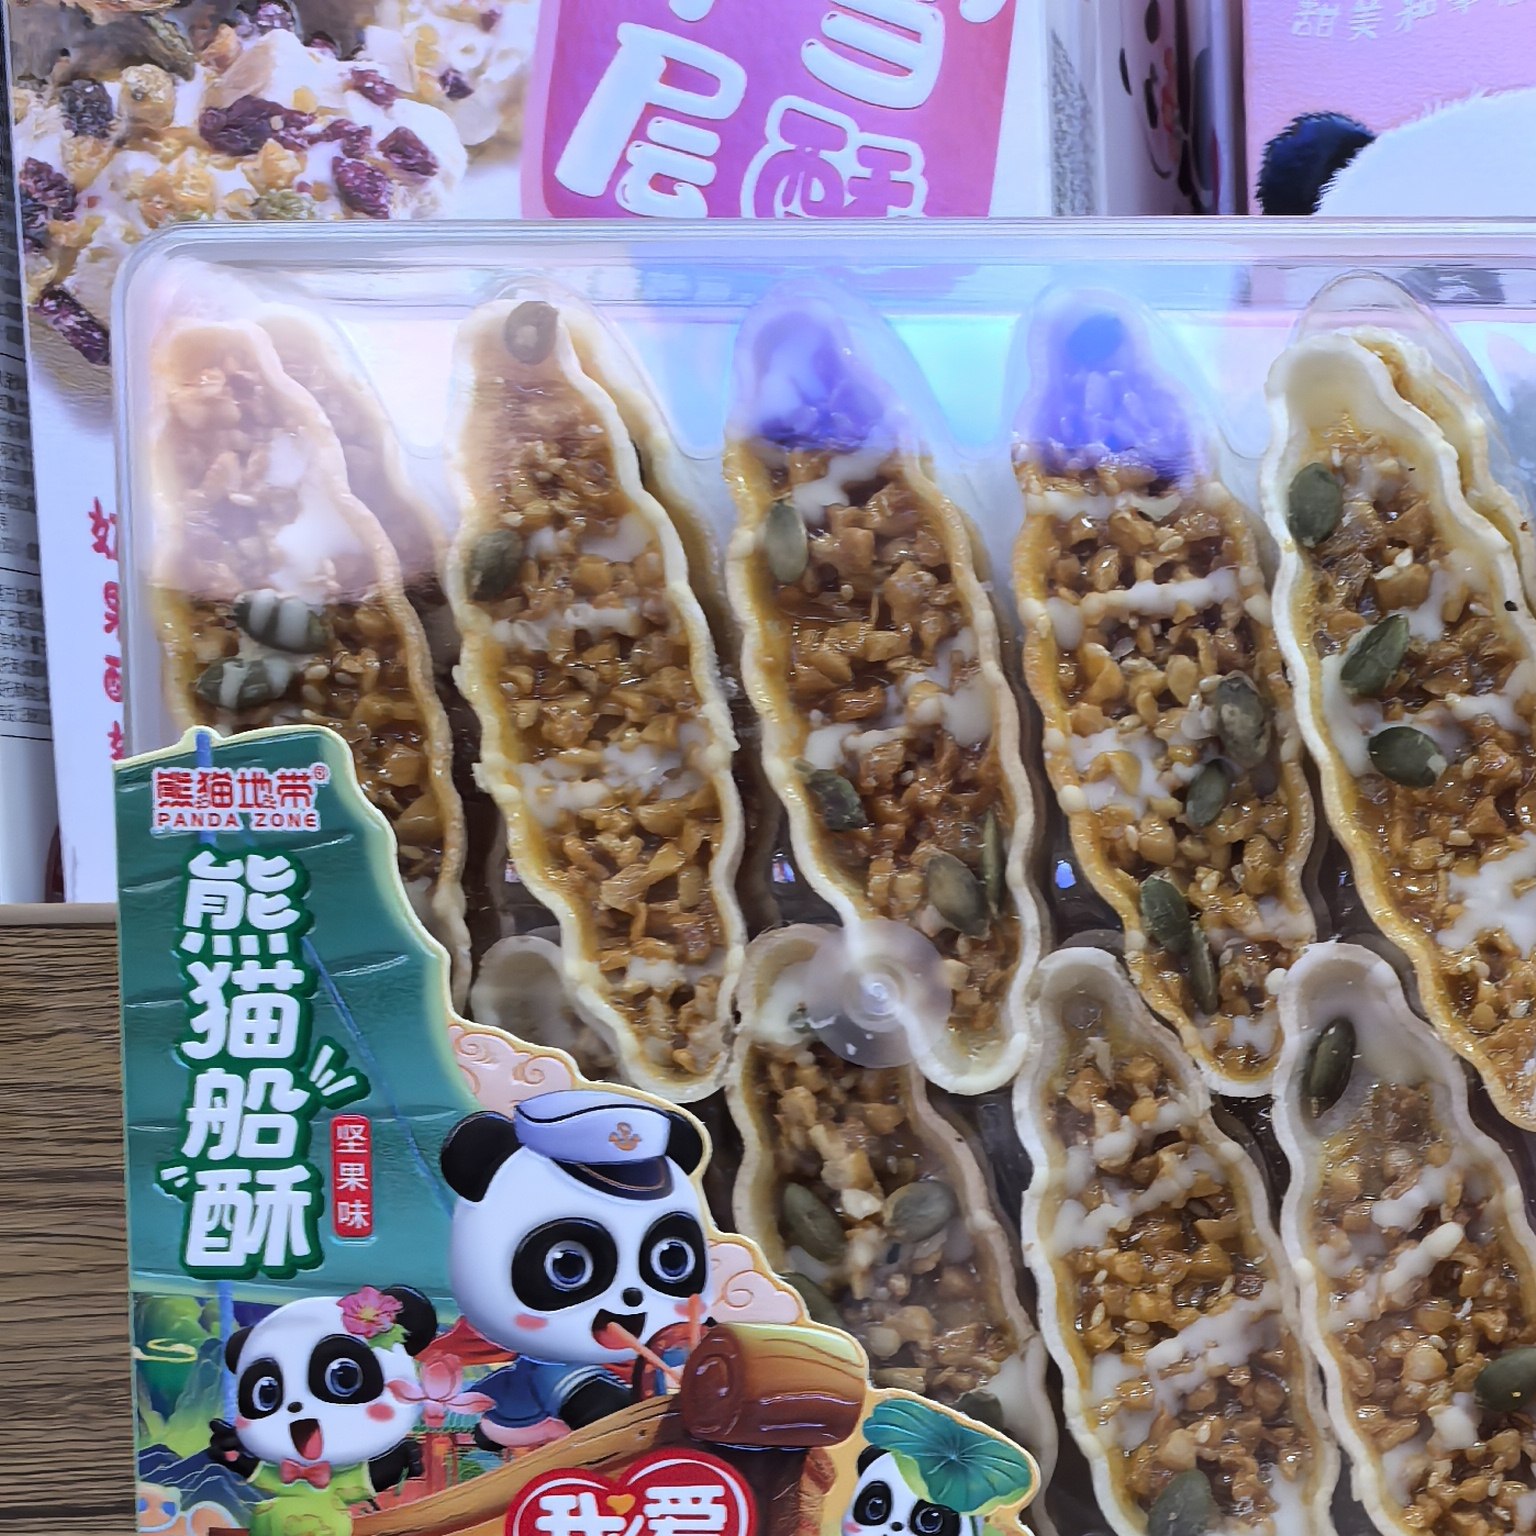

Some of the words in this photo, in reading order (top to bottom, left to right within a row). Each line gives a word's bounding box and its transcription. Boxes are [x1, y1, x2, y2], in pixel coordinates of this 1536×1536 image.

[158, 812, 241, 828] PANDA
[254, 812, 318, 828] ZONE
[180, 850, 314, 1269] 熊猫船酥
[335, 1122, 371, 1230] 坚果味
